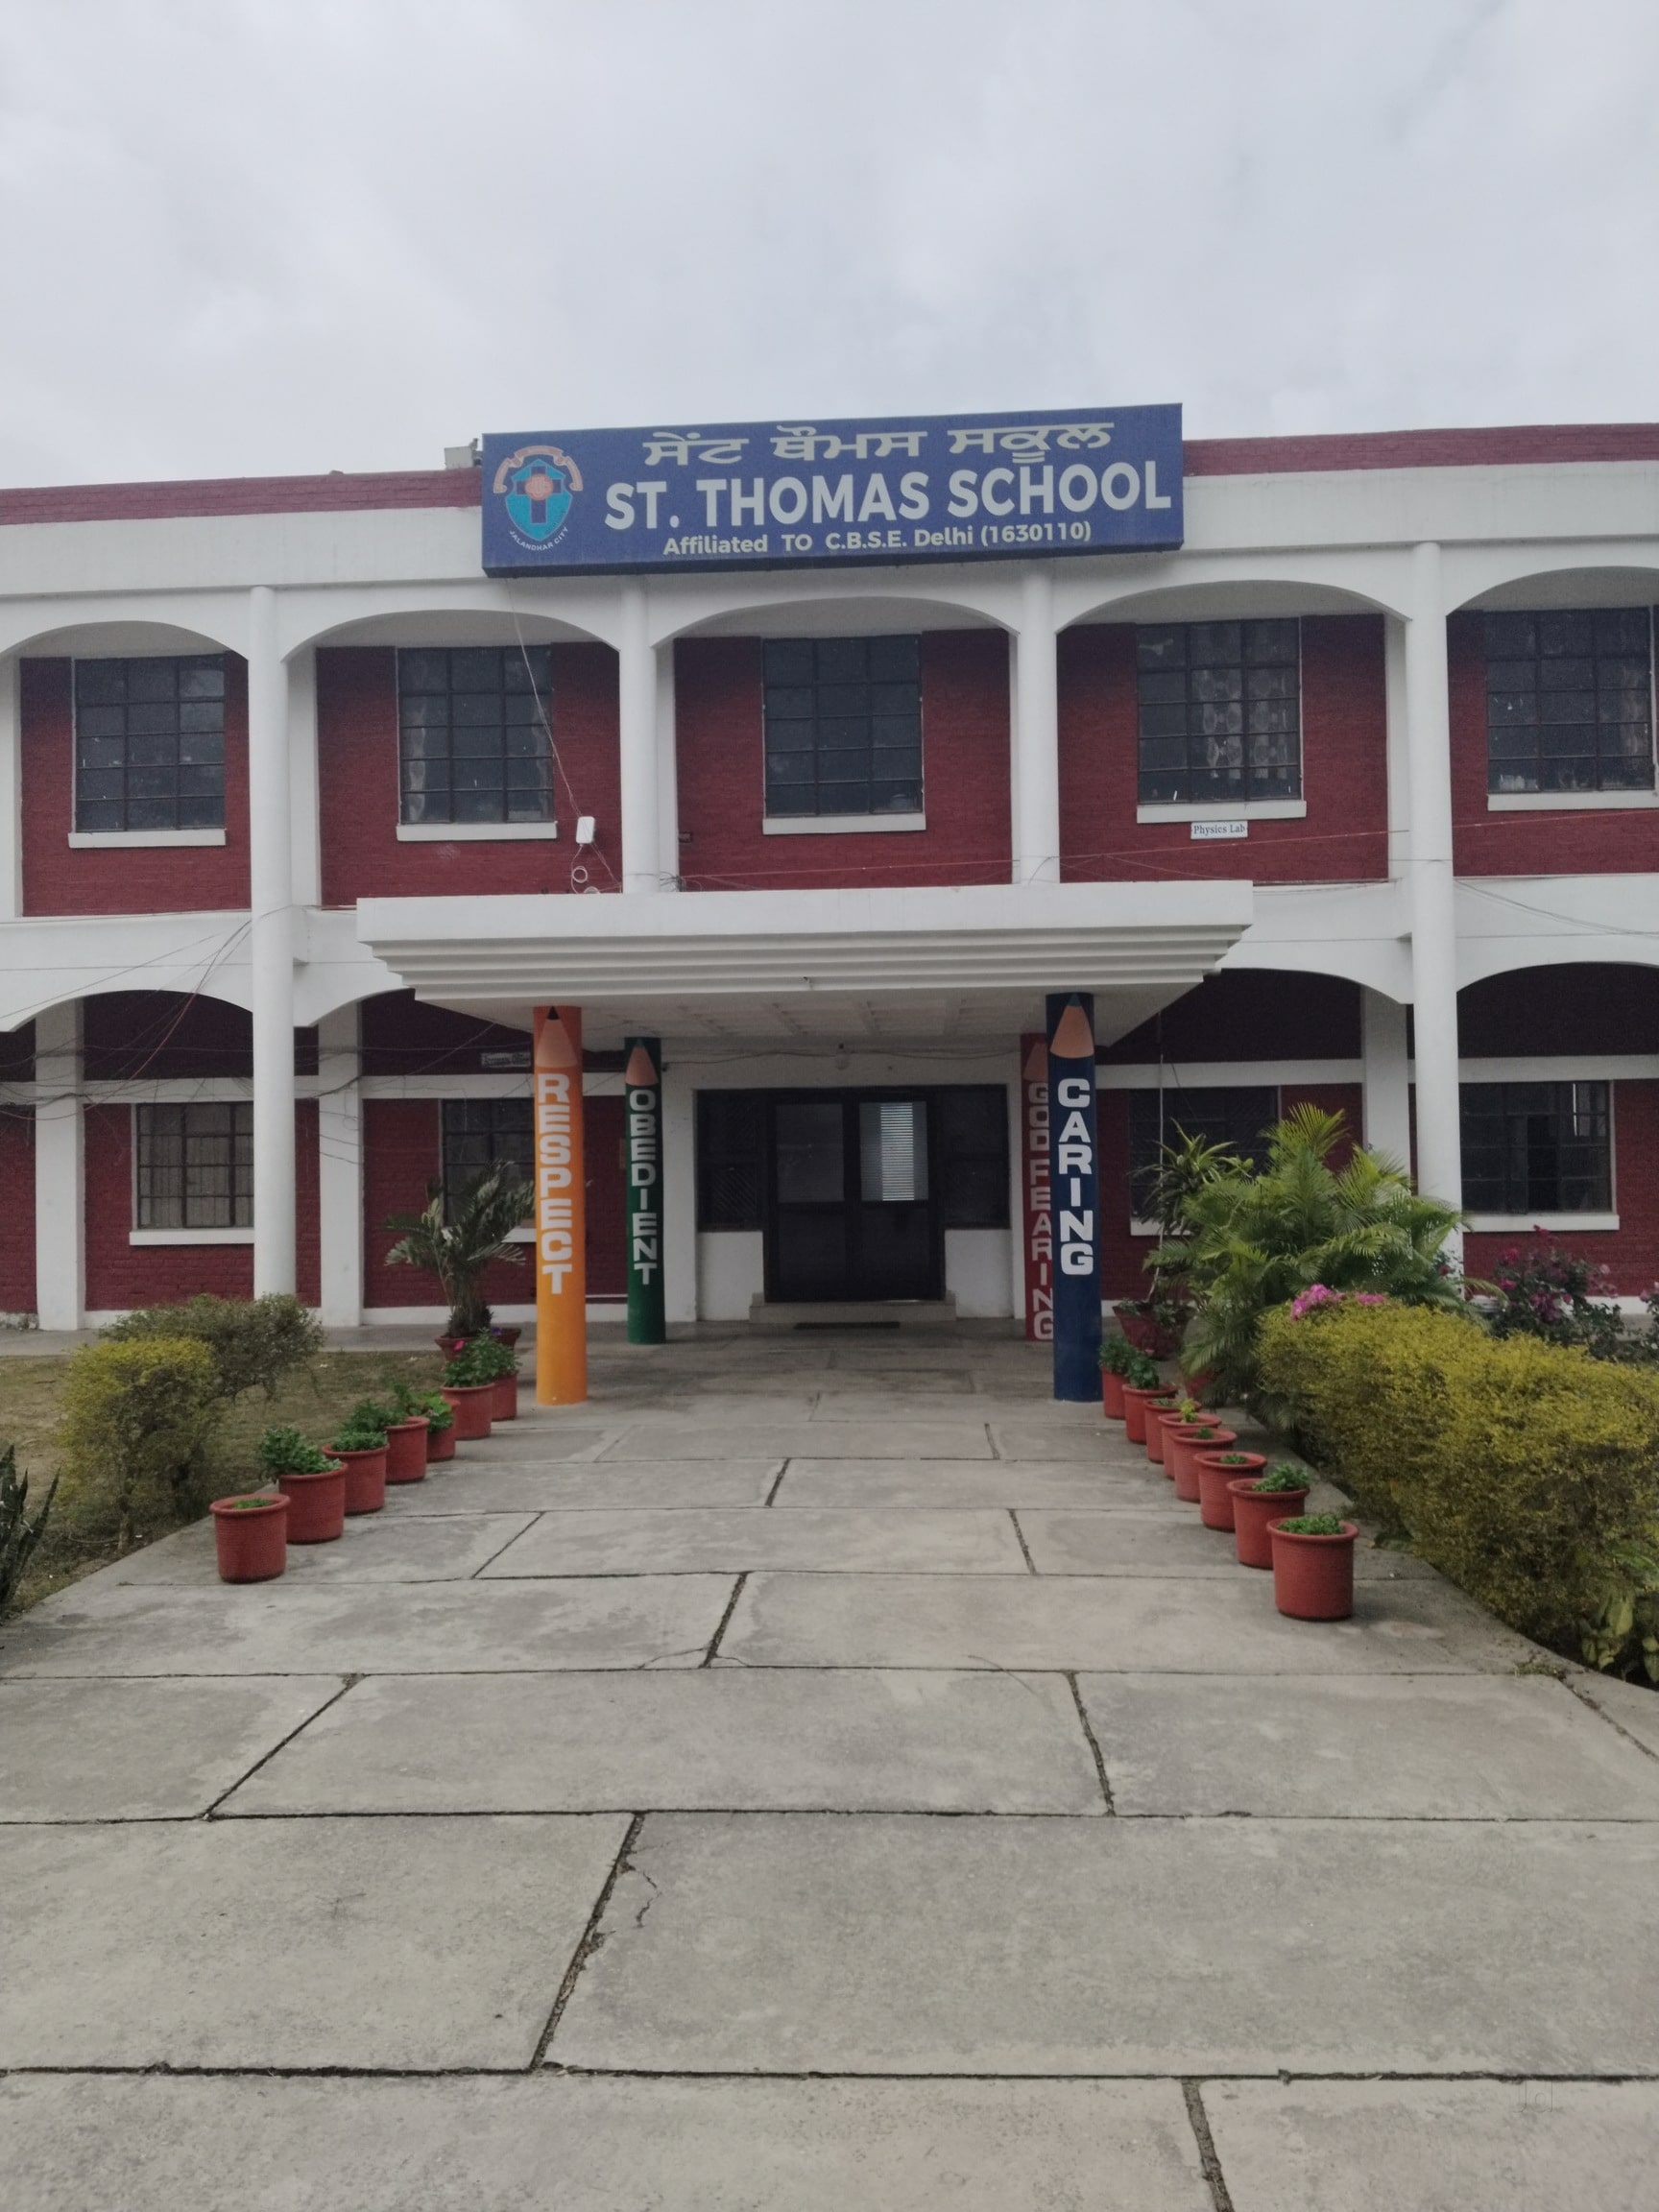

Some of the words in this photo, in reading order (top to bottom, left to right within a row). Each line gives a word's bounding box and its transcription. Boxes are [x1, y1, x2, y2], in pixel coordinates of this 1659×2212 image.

[947, 422, 1115, 464] ਸਕੂਲ
[604, 481, 681, 530] ST.
[696, 470, 930, 528] THOMAS
[947, 460, 1172, 518] SCHOOL
[509, 530, 554, 551] JALANDHAR
[554, 526, 568, 544] CITY
[662, 534, 768, 556] Affiliated
[781, 533, 814, 552] TO
[825, 529, 907, 550] C.B.S.E.
[914, 525, 974, 547] Delhi
[980, 520, 1093, 546] (1630110)
[1193, 825, 1227, 836] Physics
[1230, 824, 1245, 833] Lab
[1028, 1082, 1050, 1152] GOD
[538, 1072, 572, 1295] RESPECT
[629, 1089, 658, 1286] OBEDIENT
[1057, 1077, 1094, 1276] CARING
